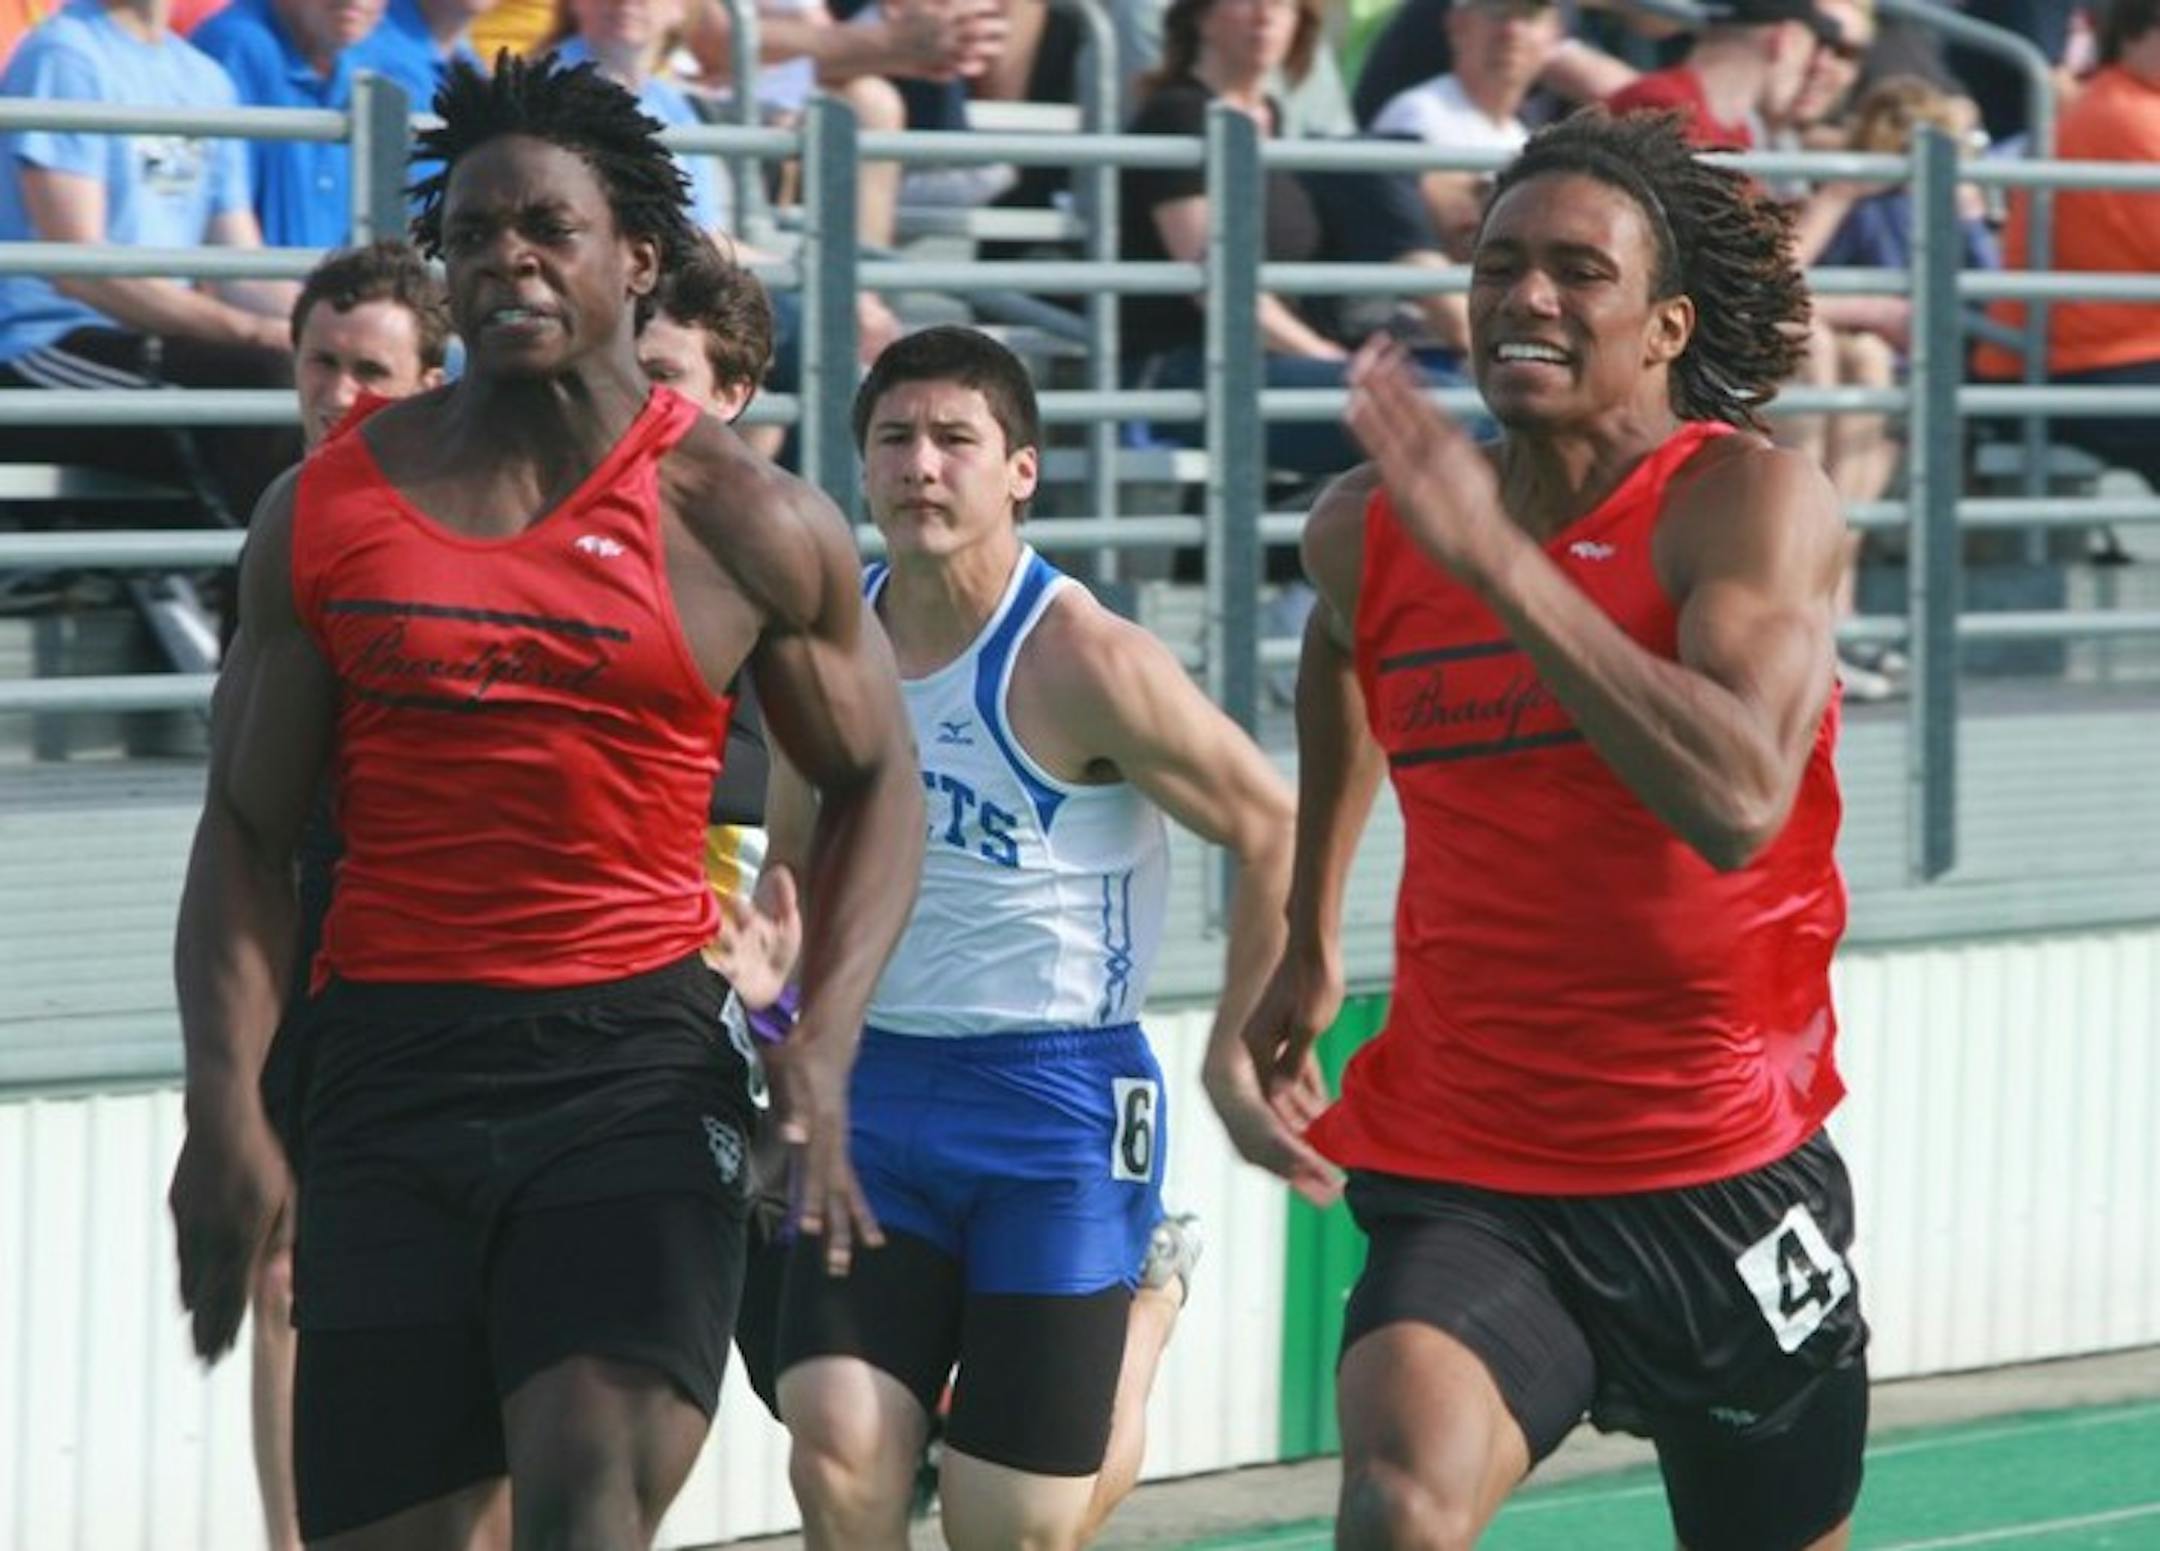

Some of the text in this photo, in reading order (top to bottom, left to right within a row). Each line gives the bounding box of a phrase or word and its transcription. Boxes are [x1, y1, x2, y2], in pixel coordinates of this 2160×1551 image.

[922, 770, 1019, 869] TS
[1121, 1087, 1151, 1176] 6
[1776, 1227, 1834, 1322] 4
